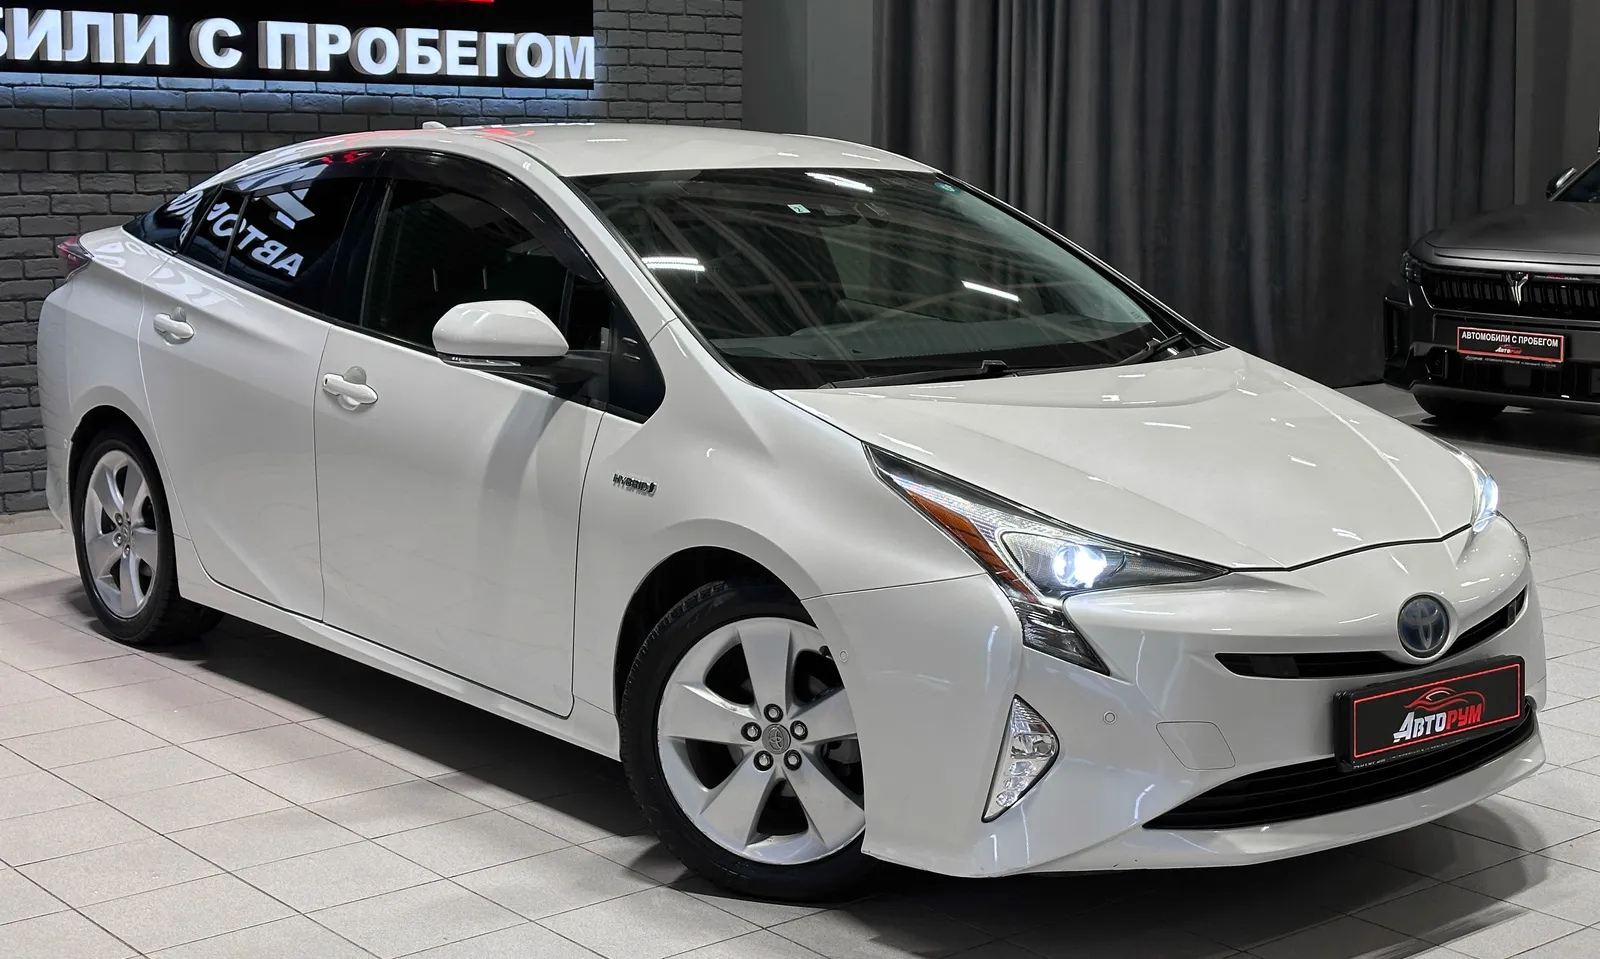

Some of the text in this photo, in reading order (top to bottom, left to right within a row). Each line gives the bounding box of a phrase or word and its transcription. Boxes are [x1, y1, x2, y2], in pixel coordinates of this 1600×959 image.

[0, 6, 594, 79] ИЛИ С ПРОБЕГОМ
[1461, 331, 1511, 343] АВТОМОБИЛИ
[1518, 336, 1559, 347] ПРОБЕГОМ
[612, 473, 649, 492] HYBRID
